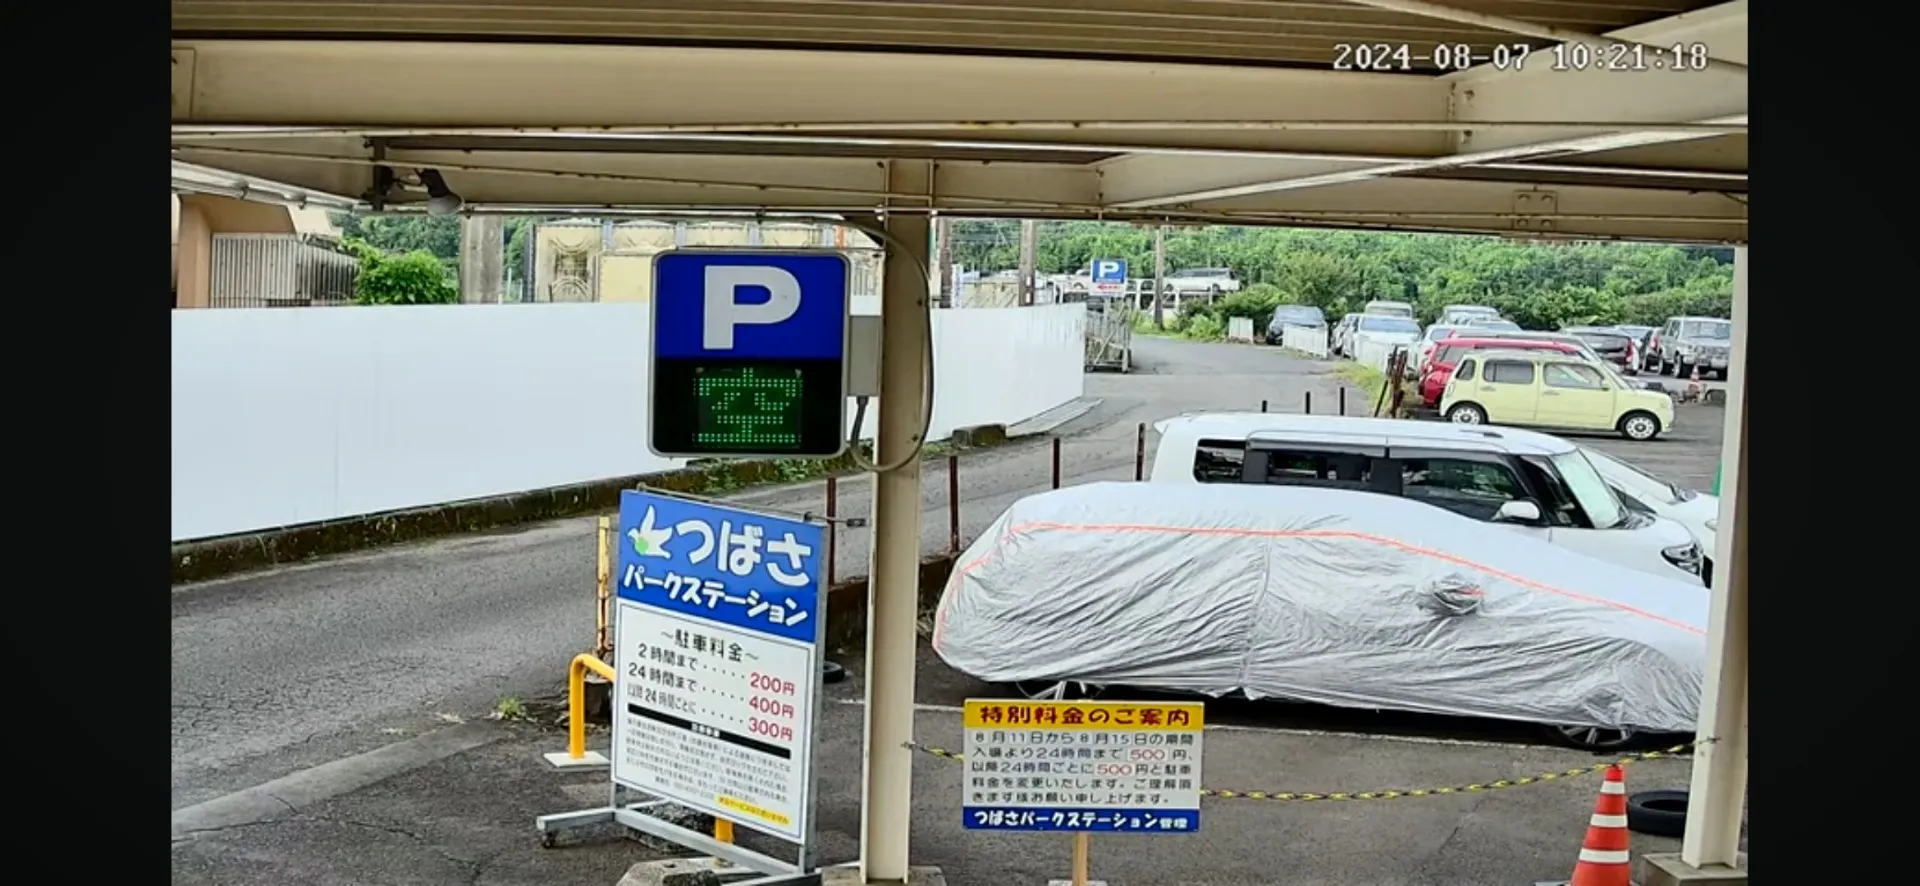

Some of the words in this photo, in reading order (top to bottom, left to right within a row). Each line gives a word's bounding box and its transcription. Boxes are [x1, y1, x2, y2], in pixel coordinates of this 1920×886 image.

[1099, 261, 1120, 278] P
[703, 265, 801, 350] P
[697, 367, 799, 443] 空
[676, 518, 812, 587] つばさ
[623, 563, 808, 627] パークステーション
[979, 706, 1191, 726] 特別料金のご案内
